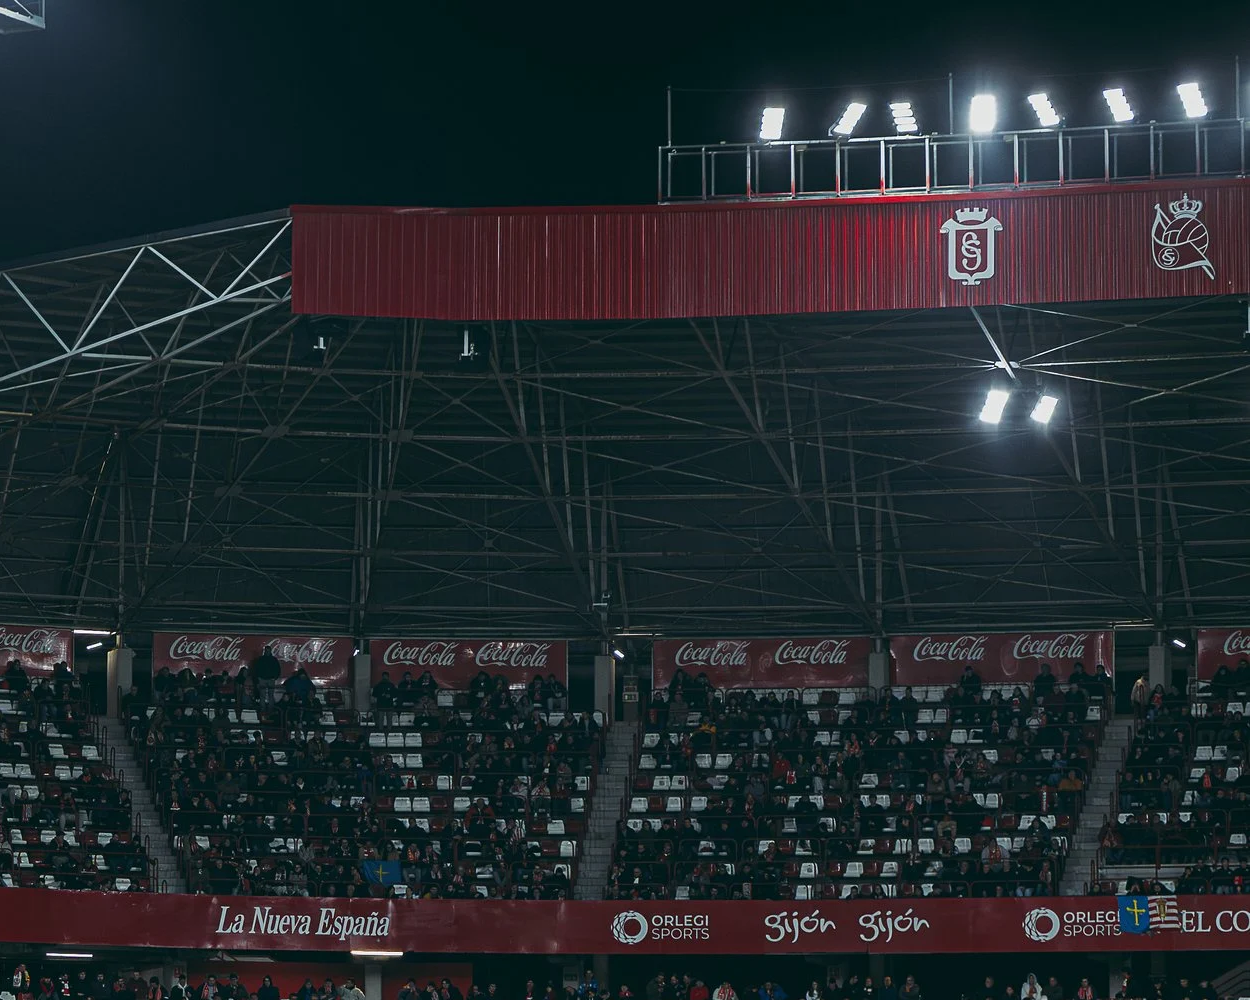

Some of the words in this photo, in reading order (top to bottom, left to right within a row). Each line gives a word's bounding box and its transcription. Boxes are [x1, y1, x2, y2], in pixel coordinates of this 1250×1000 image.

[169, 635, 245, 661] Coca-Cola
[383, 641, 459, 667] Coca-Cola
[475, 641, 552, 668] Coca-Cola
[675, 640, 751, 666] Coca-Cola
[774, 639, 851, 665] Coca-Cola
[913, 635, 989, 662] Coca-Cola
[1013, 633, 1088, 659] Coca-Cola
[215, 905, 245, 934] La
[249, 906, 310, 935] Nueva
[315, 907, 391, 941] España
[651, 914, 710, 927] ORLEGI
[1063, 924, 1122, 937] SPORTS
[1181, 910, 1211, 932] EL
[651, 928, 710, 940] SPORTS
